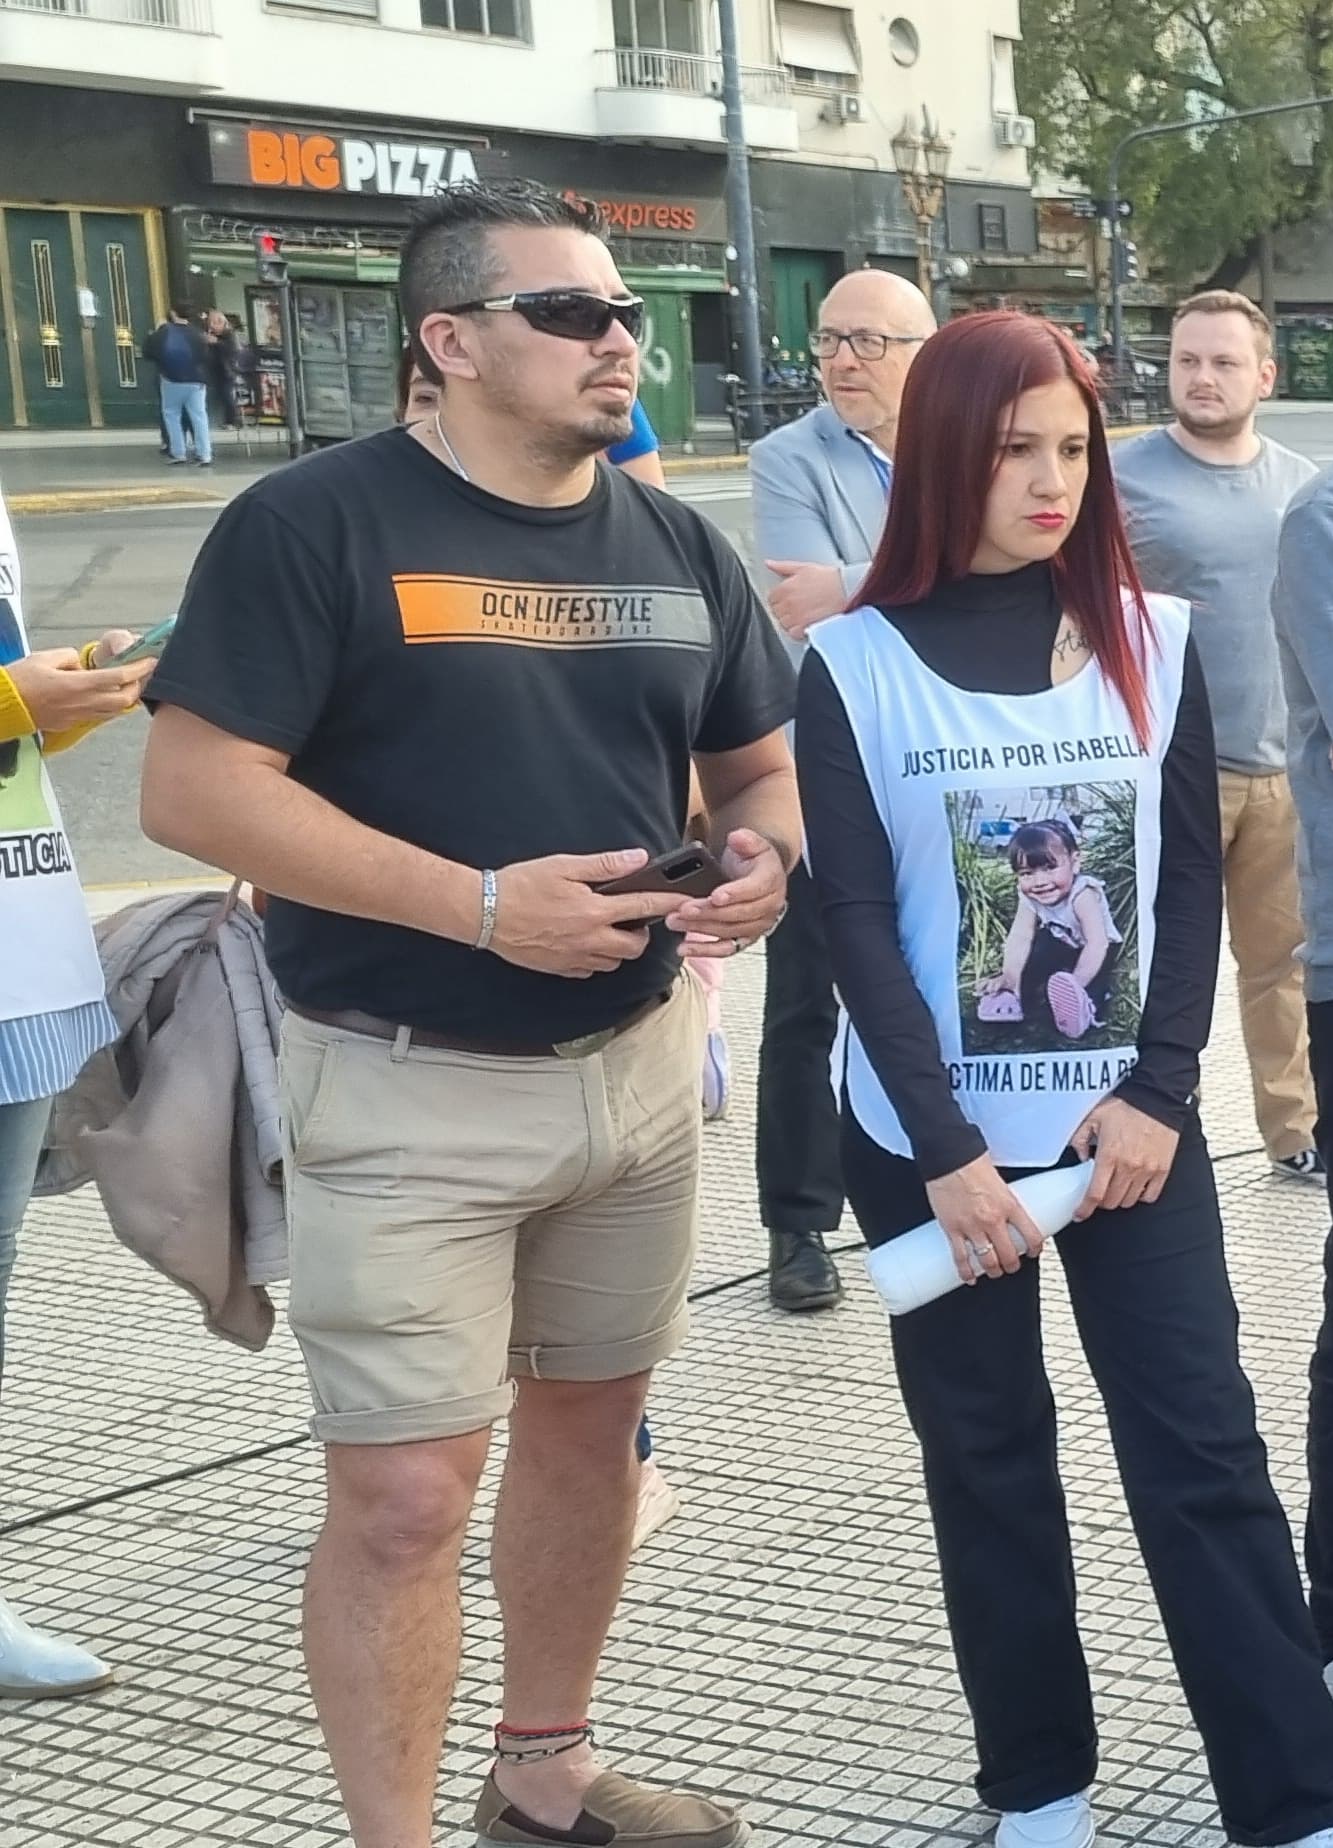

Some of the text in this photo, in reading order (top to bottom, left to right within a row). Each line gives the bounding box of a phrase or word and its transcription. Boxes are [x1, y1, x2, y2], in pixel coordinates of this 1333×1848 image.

[247, 129, 480, 198] BIG PIZZA
[598, 200, 696, 232] express
[482, 591, 653, 623] OCN LIFESTYLE
[901, 735, 1150, 779] JUSTICIA POR ISABELLA
[0, 831, 72, 879] TICIA
[949, 1062, 1014, 1092] CTIMA
[1021, 1062, 1045, 1092] DE
[1052, 1060, 1111, 1092] MALA
